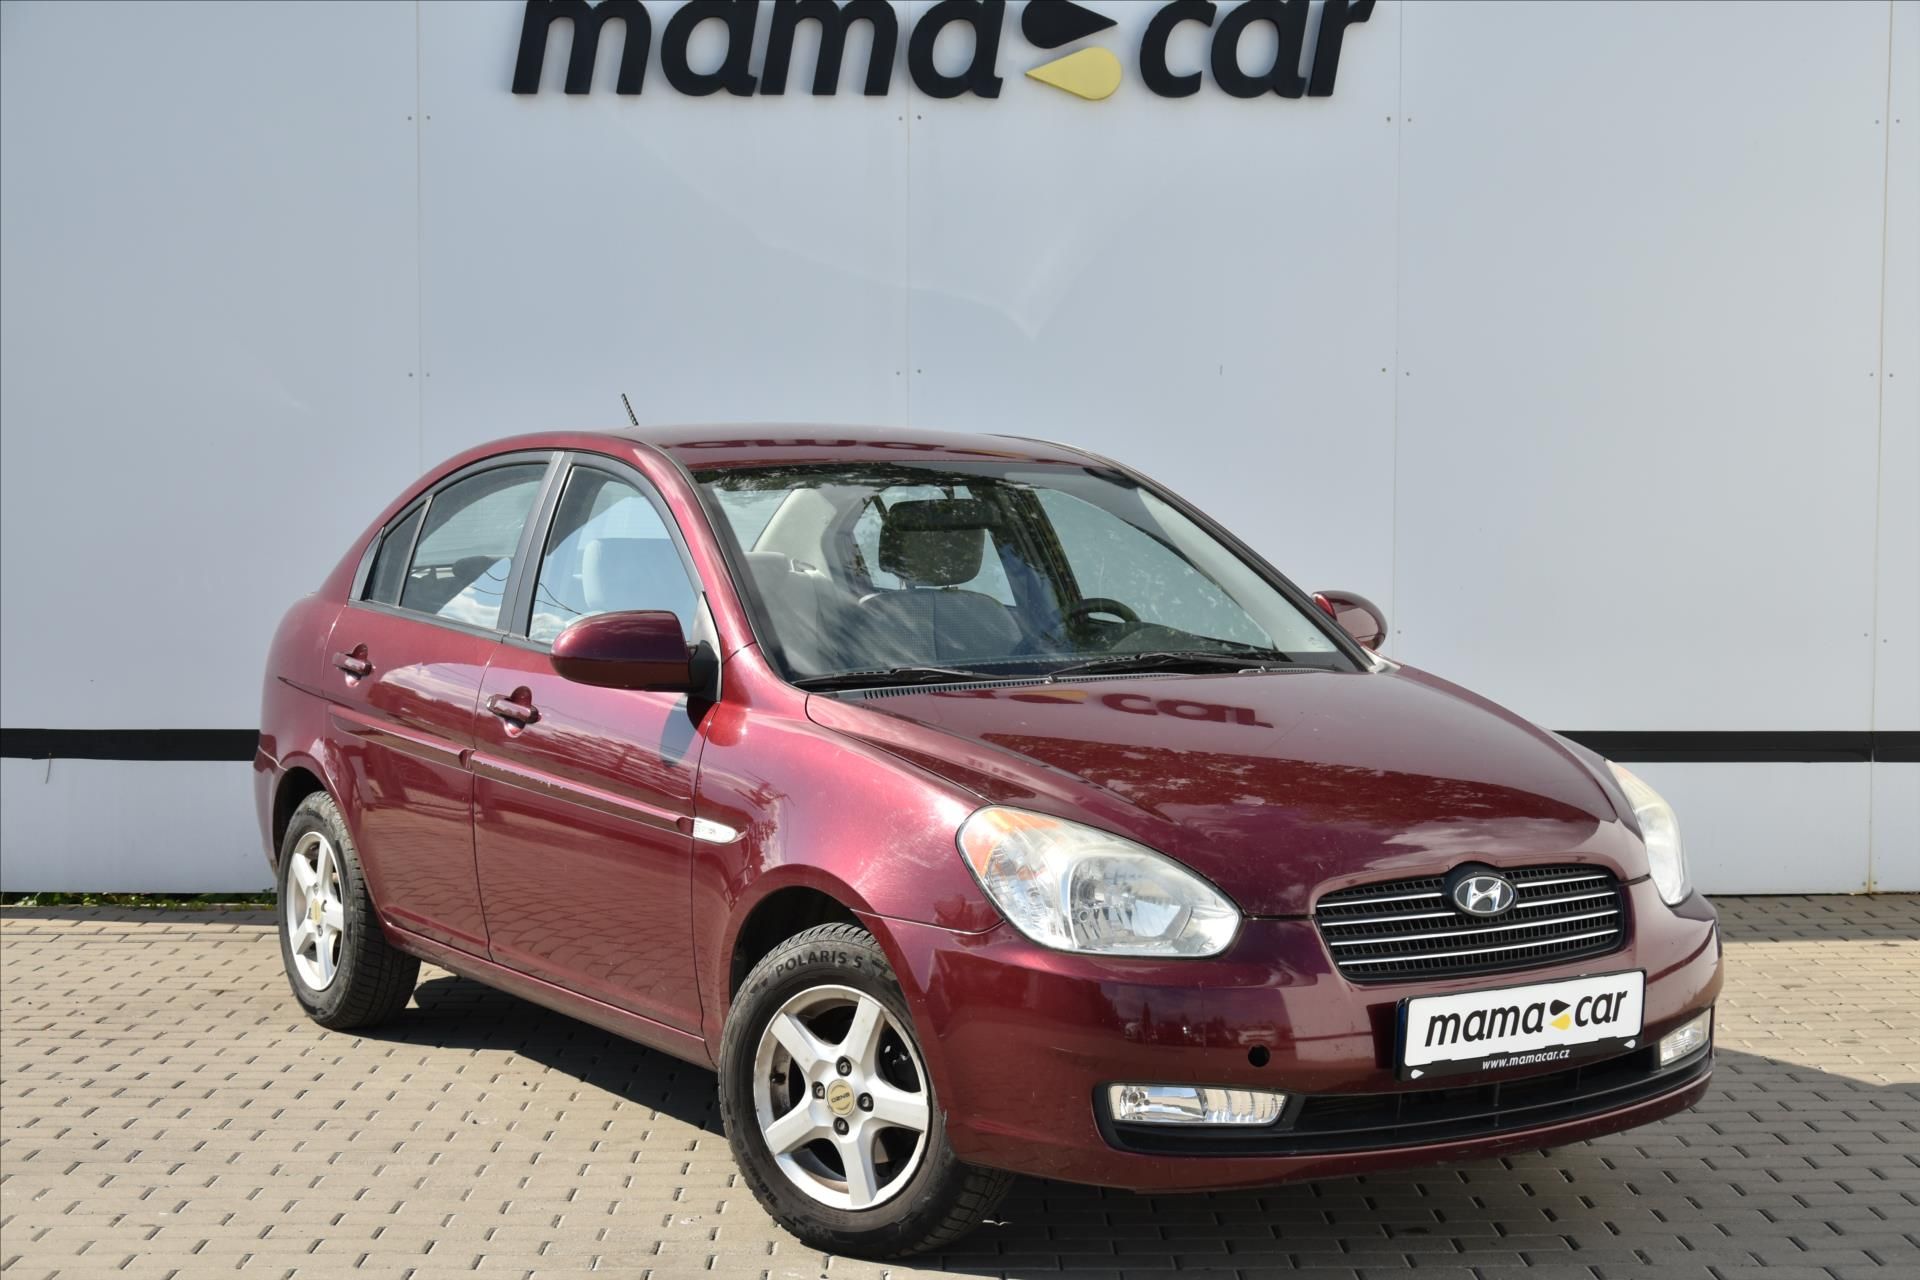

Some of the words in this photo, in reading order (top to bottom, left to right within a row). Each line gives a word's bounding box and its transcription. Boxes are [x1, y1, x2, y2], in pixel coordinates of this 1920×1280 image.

[513, 0, 1004, 99] mama
[1139, 0, 1374, 98] car
[775, 950, 848, 977] POLARIS
[1424, 1001, 1546, 1048] mama
[1574, 990, 1628, 1028] car
[1482, 1048, 1571, 1071] www.mamacar.cz
